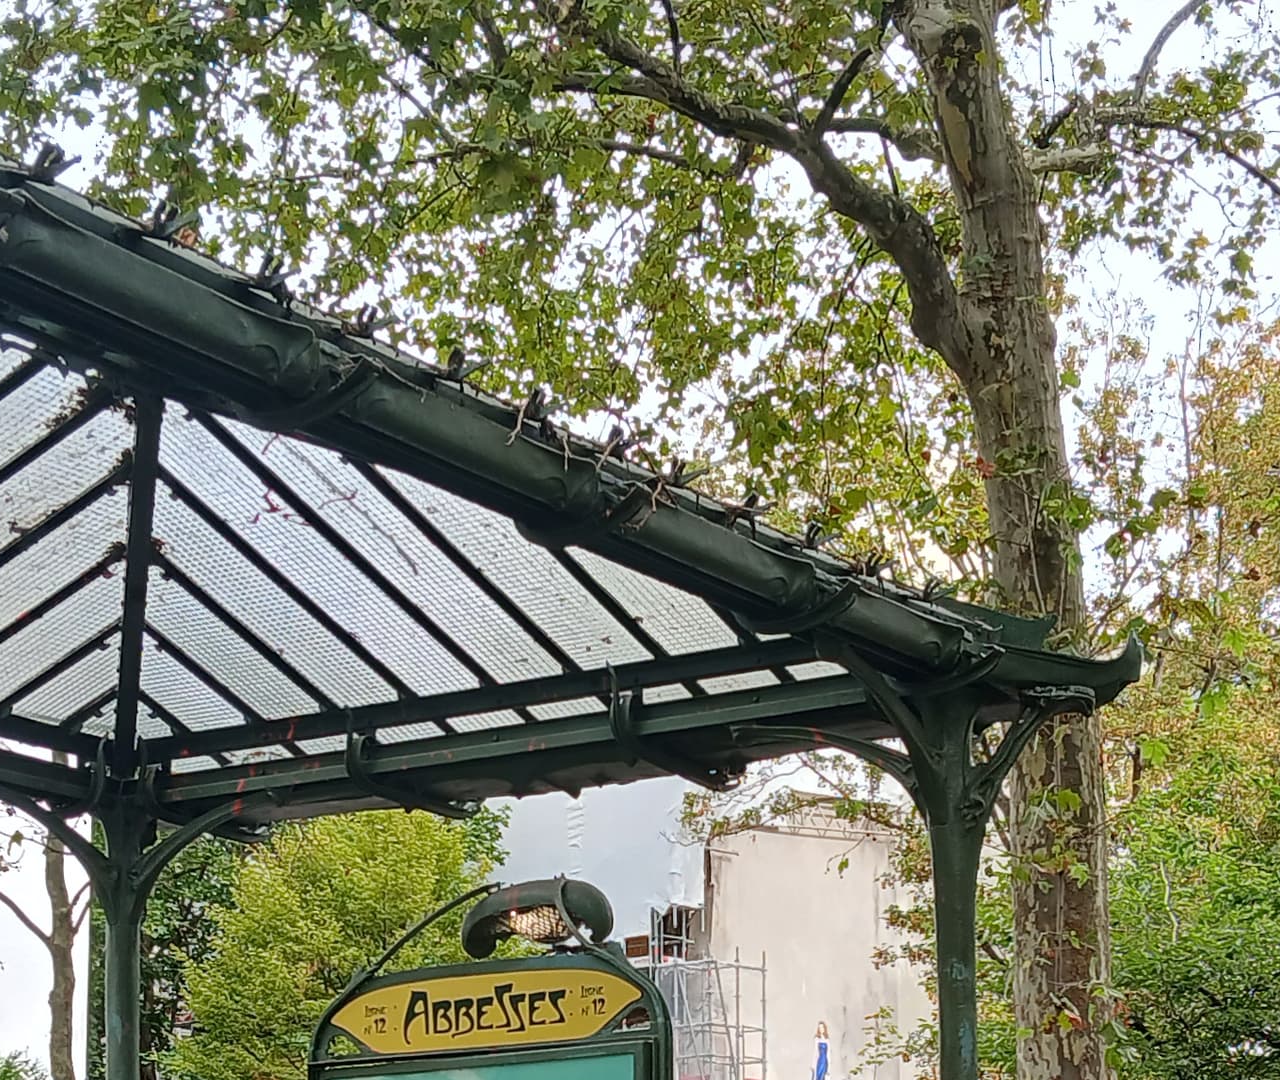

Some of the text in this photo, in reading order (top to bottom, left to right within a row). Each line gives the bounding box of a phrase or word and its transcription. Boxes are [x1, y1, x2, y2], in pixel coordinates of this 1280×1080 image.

[404, 983, 567, 1045] ABBESSES
[592, 998, 606, 1015] 12
[374, 1018, 387, 1034] 12
